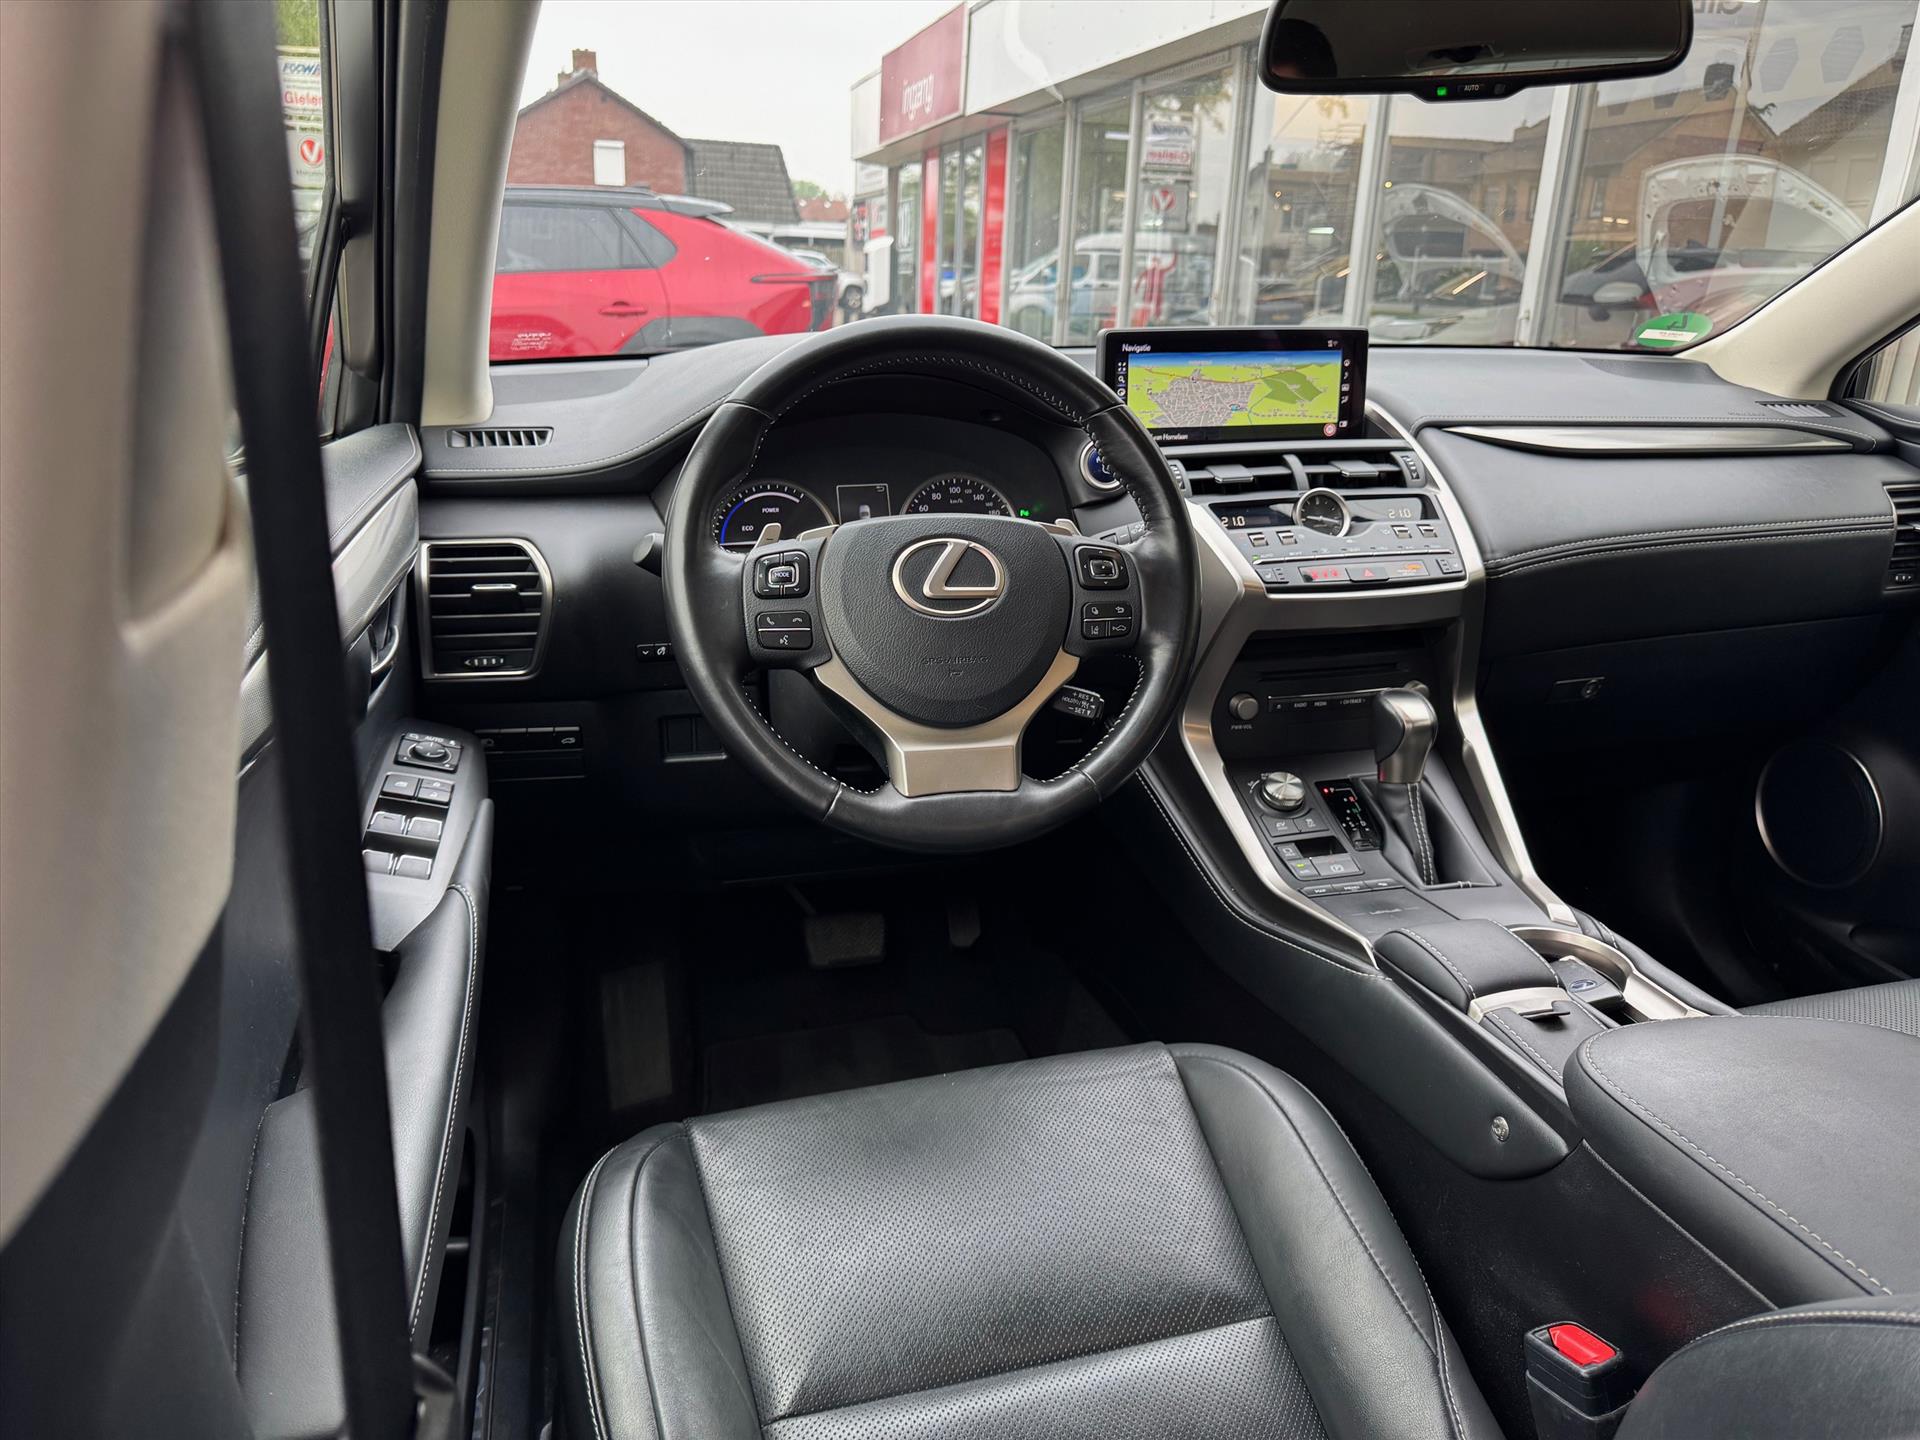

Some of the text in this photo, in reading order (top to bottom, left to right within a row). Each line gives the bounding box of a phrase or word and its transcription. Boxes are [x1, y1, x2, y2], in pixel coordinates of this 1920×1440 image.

[1464, 84, 1480, 92] AUTO
[1121, 343, 1152, 354] Navigatie
[949, 486, 961, 494] 100
[931, 492, 942, 501] 80
[973, 493, 985, 501] 140
[919, 504, 929, 512] 60
[424, 735, 445, 743] AUTO
